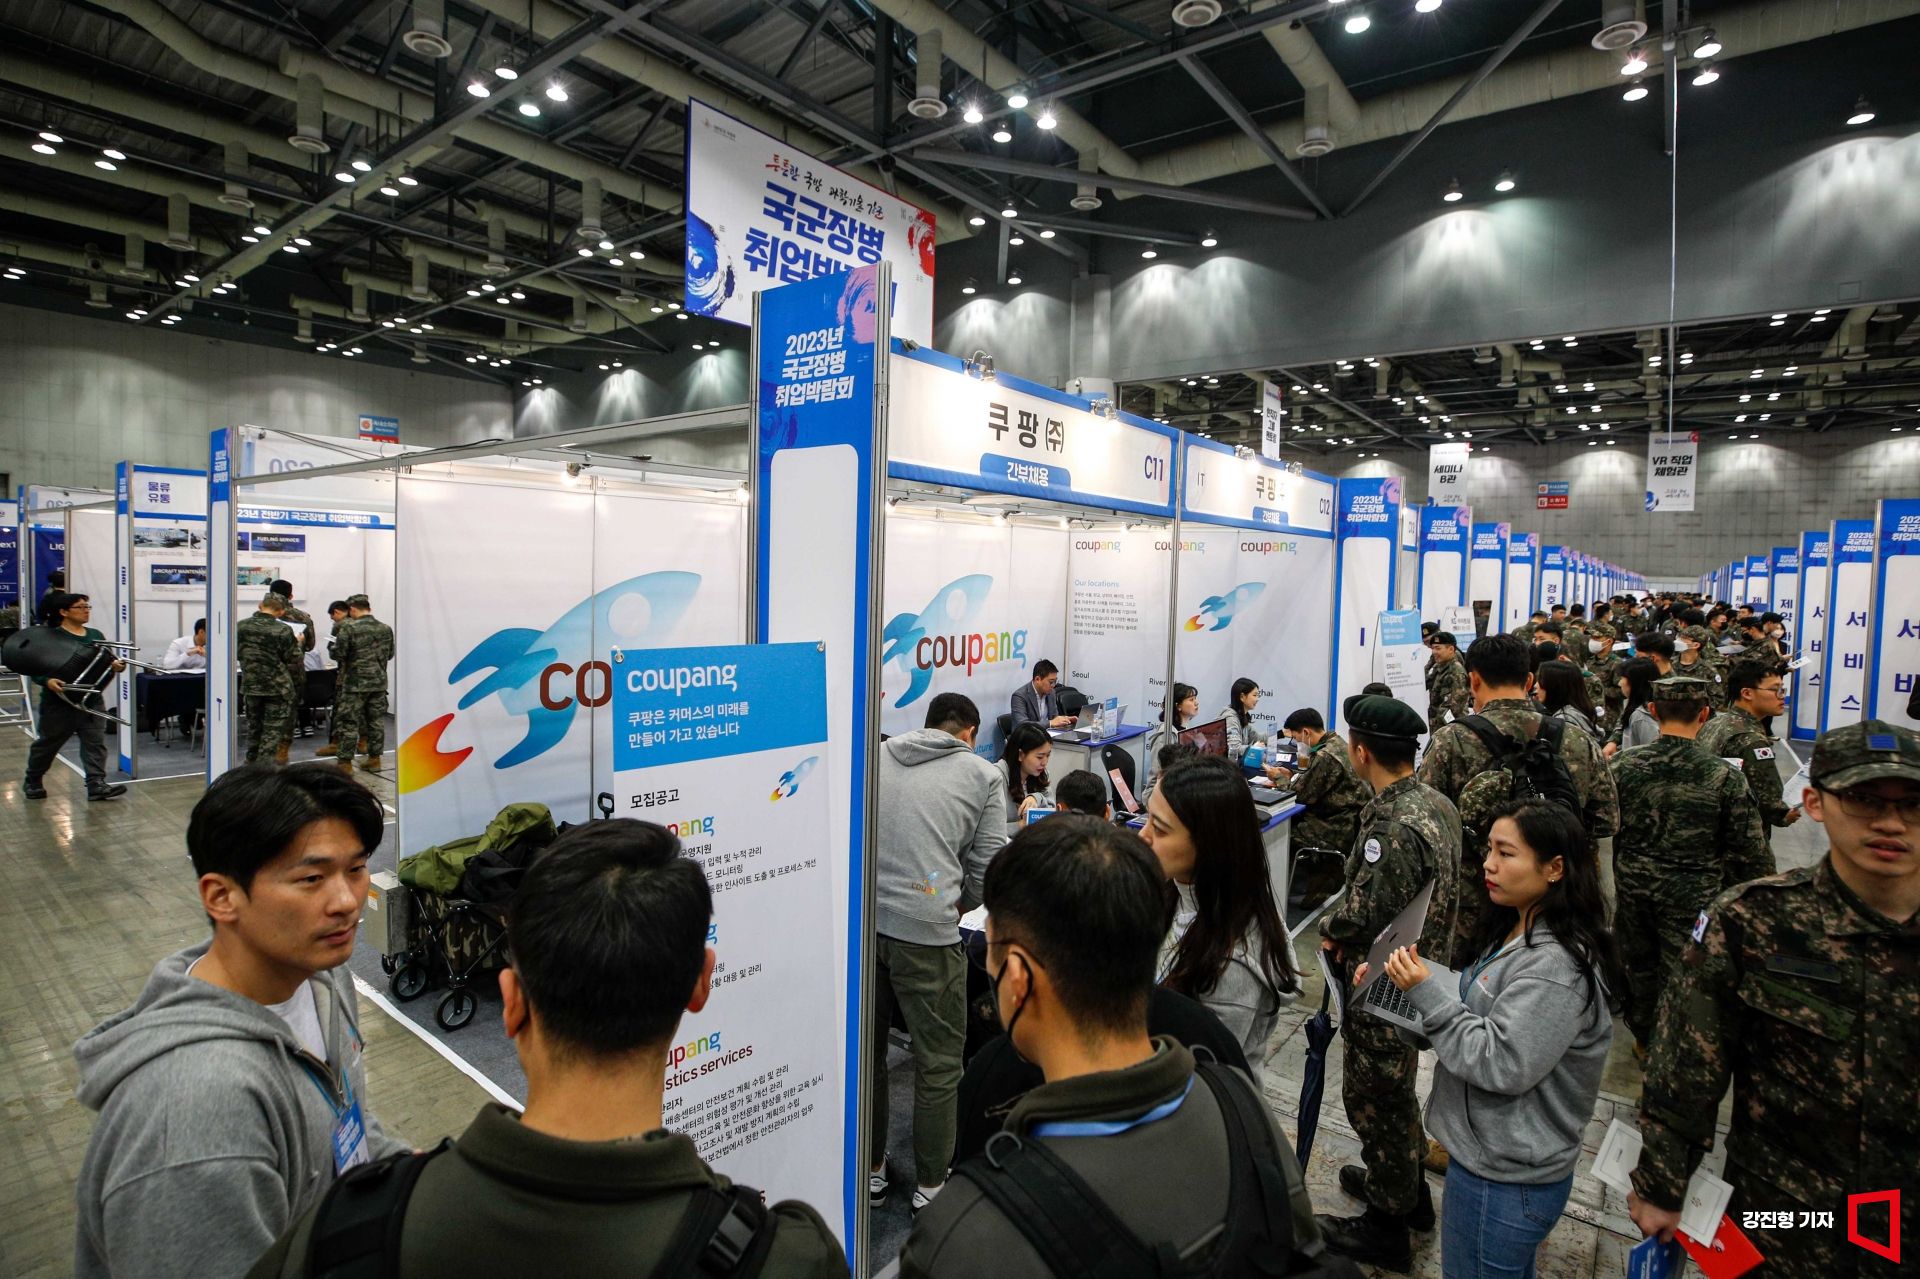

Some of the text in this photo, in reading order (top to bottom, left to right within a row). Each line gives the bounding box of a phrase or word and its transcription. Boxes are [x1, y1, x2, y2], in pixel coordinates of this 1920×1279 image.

[804, 171, 822, 193] 국방
[829, 187, 864, 212] 과학기술
[763, 180, 885, 264] 국군장병
[785, 325, 845, 356] 2023년
[782, 350, 847, 380] 국군장병
[775, 375, 855, 408] 취업박람회
[1144, 455, 1163, 481] C11
[1434, 464, 1463, 474] 세미나
[1652, 455, 1693, 465] VR 직업
[1007, 461, 1049, 487] 간부채용
[1197, 472, 1205, 486] IT
[1440, 475, 1457, 484] B관
[1654, 466, 1688, 476] 체험관
[149, 482, 170, 492] 물류
[149, 493, 170, 504] 유통
[1319, 498, 1330, 515] C12
[1351, 504, 1385, 513] 국군장병
[1353, 495, 1383, 504] 2023년
[237, 509, 371, 524] 23년 전반기 국군장병 취업박람회
[1347, 513, 1388, 523] 취업박람회
[1075, 540, 1120, 553] coupang
[1241, 541, 1297, 555] coupang
[916, 629, 1028, 676] coupang
[627, 663, 737, 697] coupang
[1072, 671, 1090, 679] Seoul
[628, 701, 749, 727] 쿠팡은 커머스의 미래를
[1251, 713, 1276, 721] nzhen
[629, 722, 740, 749] 만들어 가고 있습니다
[630, 789, 679, 809] 모집공고
[708, 855, 722, 867] 입력
[724, 853, 731, 863] 및
[733, 850, 746, 861] 누적
[748, 846, 762, 857] 관리
[715, 864, 743, 879] 모니터링
[725, 875, 752, 890] 인사이트
[754, 872, 767, 882] 도출
[769, 868, 776, 878] 및
[777, 862, 803, 876] 프로세스
[804, 858, 817, 868] 개선
[724, 972, 737, 983] 대응
[740, 968, 746, 979] 및
[748, 963, 761, 975] 관리
[663, 1045, 753, 1091] stics services
[665, 1064, 789, 1125] 배송센터의 안전보건 계획 수립 및 관리
[706, 1105, 728, 1121] 위험성
[729, 1098, 744, 1111] 평가
[745, 1094, 753, 1104] 및
[754, 1087, 768, 1100] 개선
[769, 1080, 783, 1092] 관리
[692, 1073, 824, 1142] 안전교육 및 안전문화 향상을 위한 교육 실시
[725, 1129, 733, 1140] 및
[734, 1123, 749, 1136] 재발
[750, 1115, 764, 1129] 방지
[765, 1104, 786, 1120] 계획의
[787, 1097, 800, 1111] 수립
[745, 1131, 759, 1144] 정한
[760, 1111, 800, 1137] 안전관리자의
[801, 1103, 814, 1117] 업무
